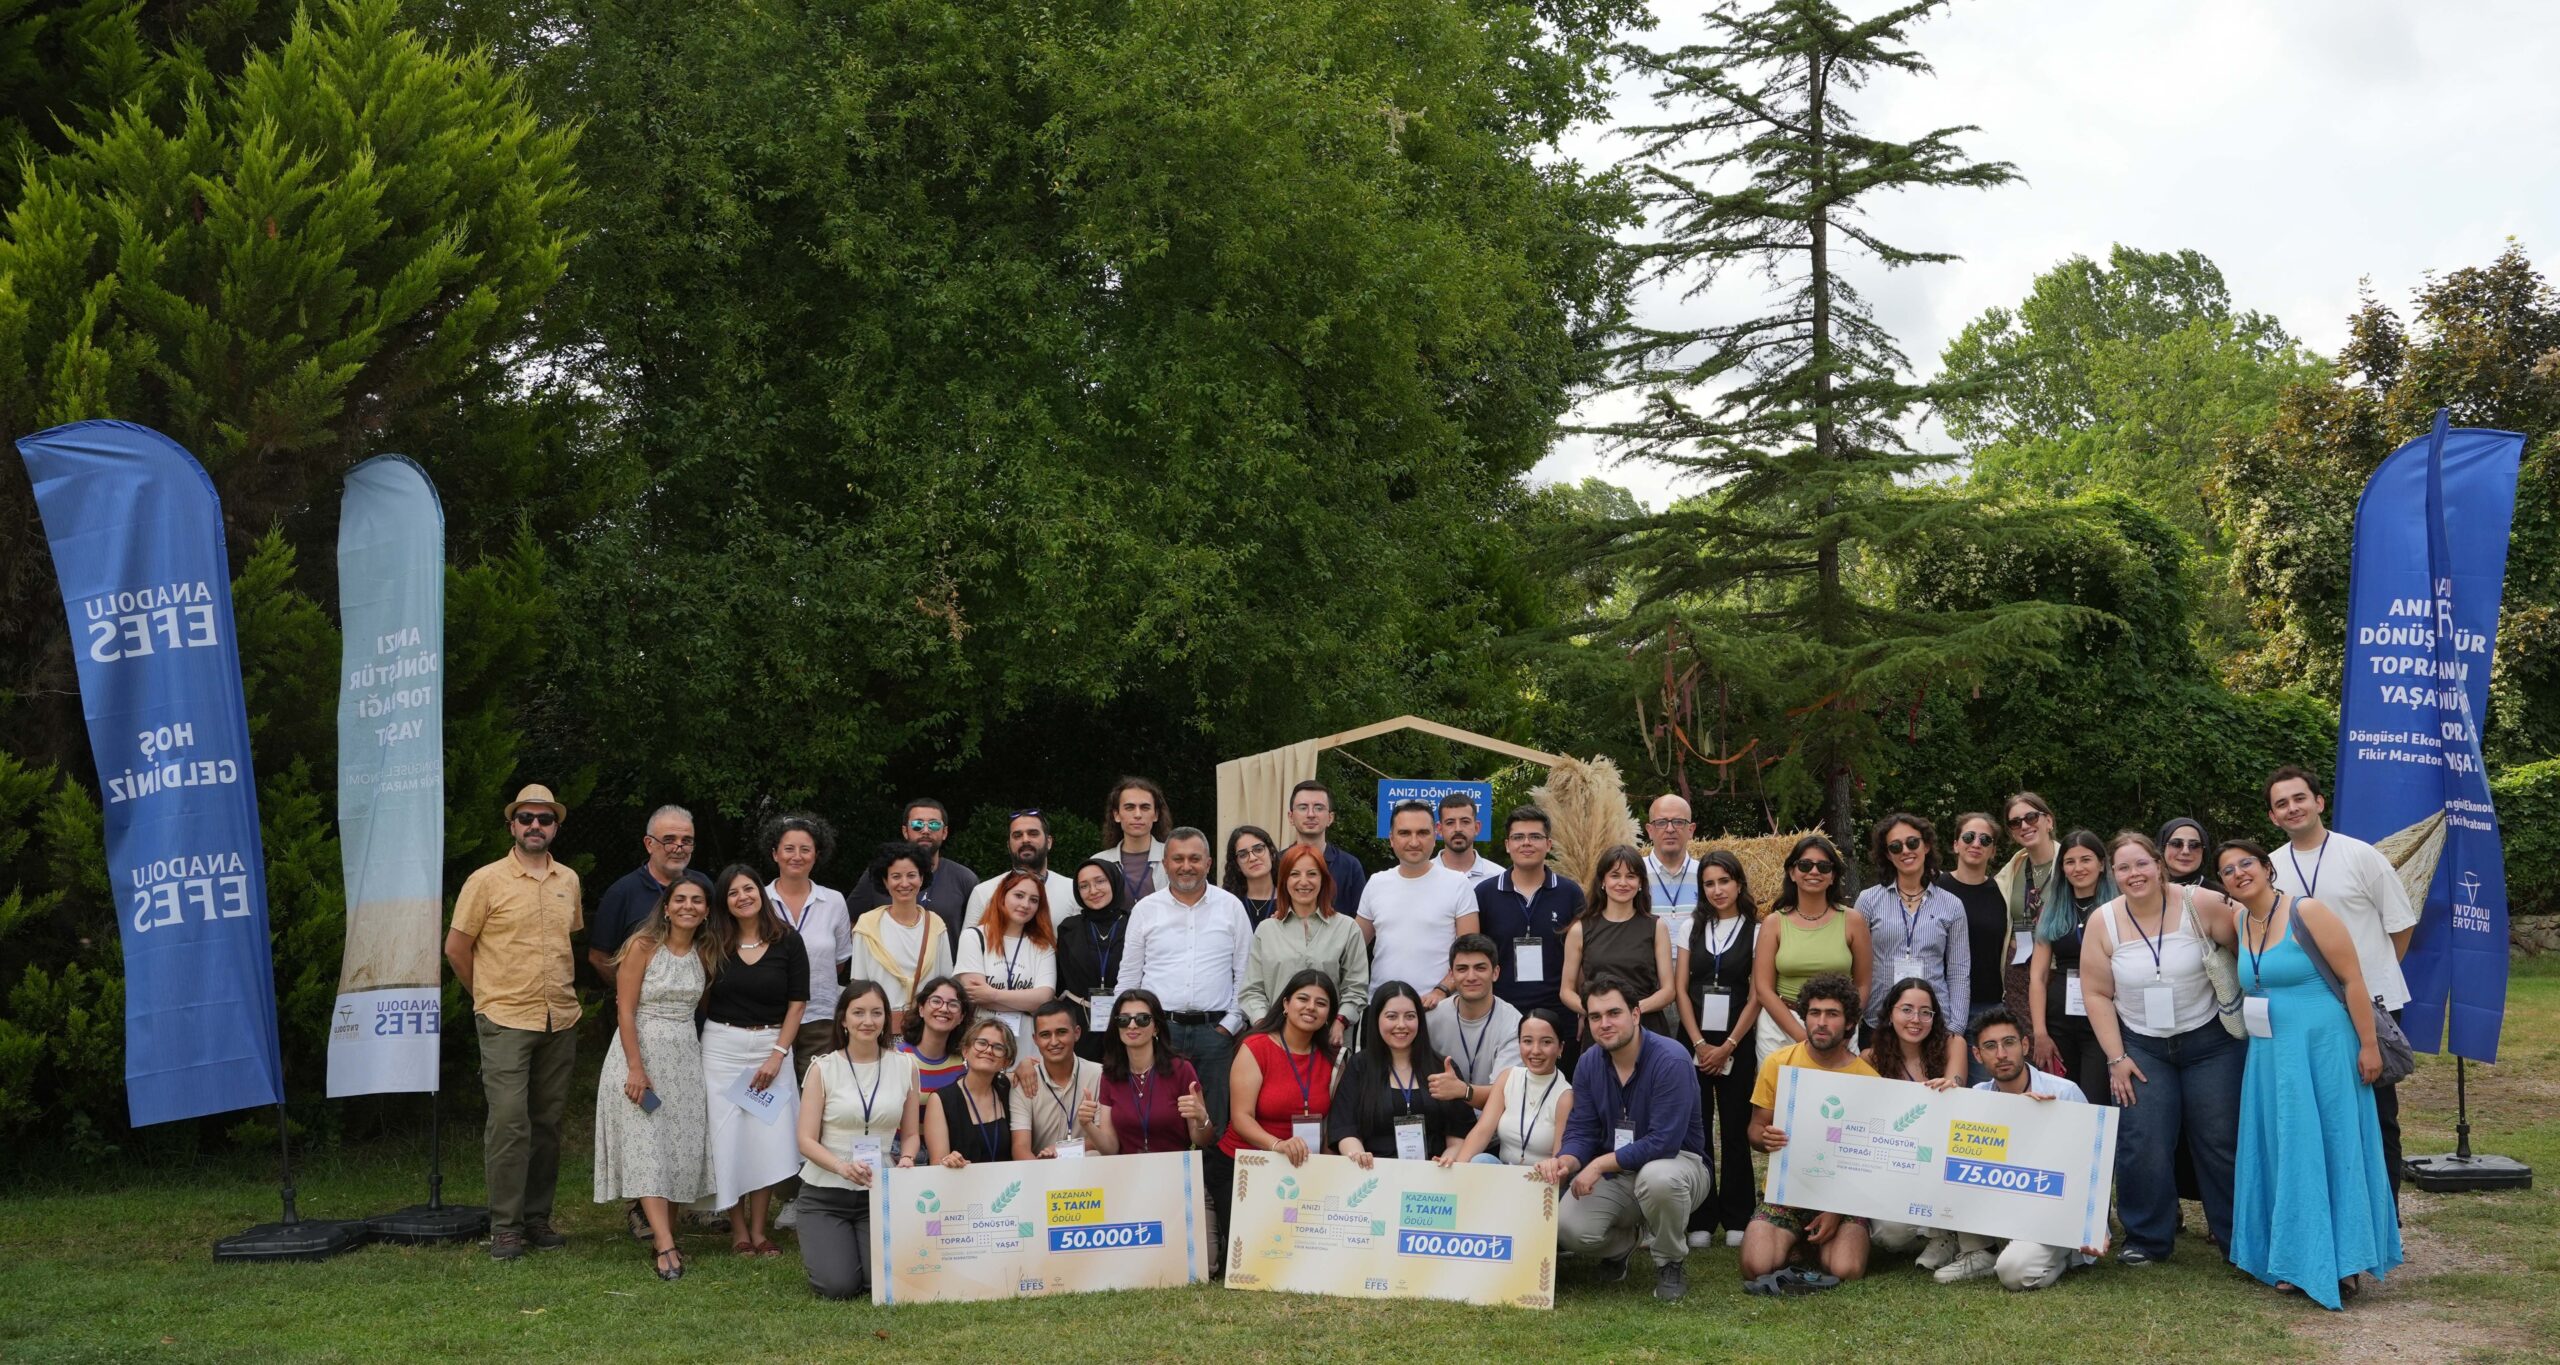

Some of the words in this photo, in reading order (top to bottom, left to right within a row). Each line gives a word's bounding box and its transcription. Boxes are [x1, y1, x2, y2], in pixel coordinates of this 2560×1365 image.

[2349, 731, 2408, 745] Döngüsel
[2358, 749, 2387, 760] Fikir
[1388, 787, 1418, 797] ANIZI
[1845, 1124, 1866, 1132] ANIZI
[1954, 1122, 1998, 1134] KAZANAN
[1952, 1132, 1963, 1142] 2.
[1966, 1134, 2005, 1147] TAKIM
[1839, 1146, 1871, 1156] TOPRAĞI
[1951, 1145, 1983, 1156] ÖDÜLÜ
[1891, 1161, 1916, 1170] YAŞAT
[1051, 1191, 1093, 1199] KAZANAN
[1406, 1194, 1446, 1202] KAZANAN
[1051, 1202, 1062, 1211] 3.
[1064, 1200, 1102, 1211] TAKIM
[1301, 1203, 1321, 1211] ANIZI
[1405, 1204, 1413, 1213] 1.
[1416, 1204, 1453, 1215] TAKIM
[1908, 1206, 1933, 1217] EFES
[944, 1214, 965, 1222] ANIZI
[1051, 1213, 1081, 1223] ÖDÜLÜ
[1404, 1216, 1433, 1226] ÖDÜLÜ
[1295, 1226, 1327, 1235] TOPRAĞI
[941, 1236, 974, 1245] TOPRAĞI
[995, 1241, 1019, 1249] YAŞAT
[1347, 1237, 1370, 1245] YAŞAT
[1020, 1282, 1044, 1291] EFES
[1364, 1281, 1388, 1291] EFES
